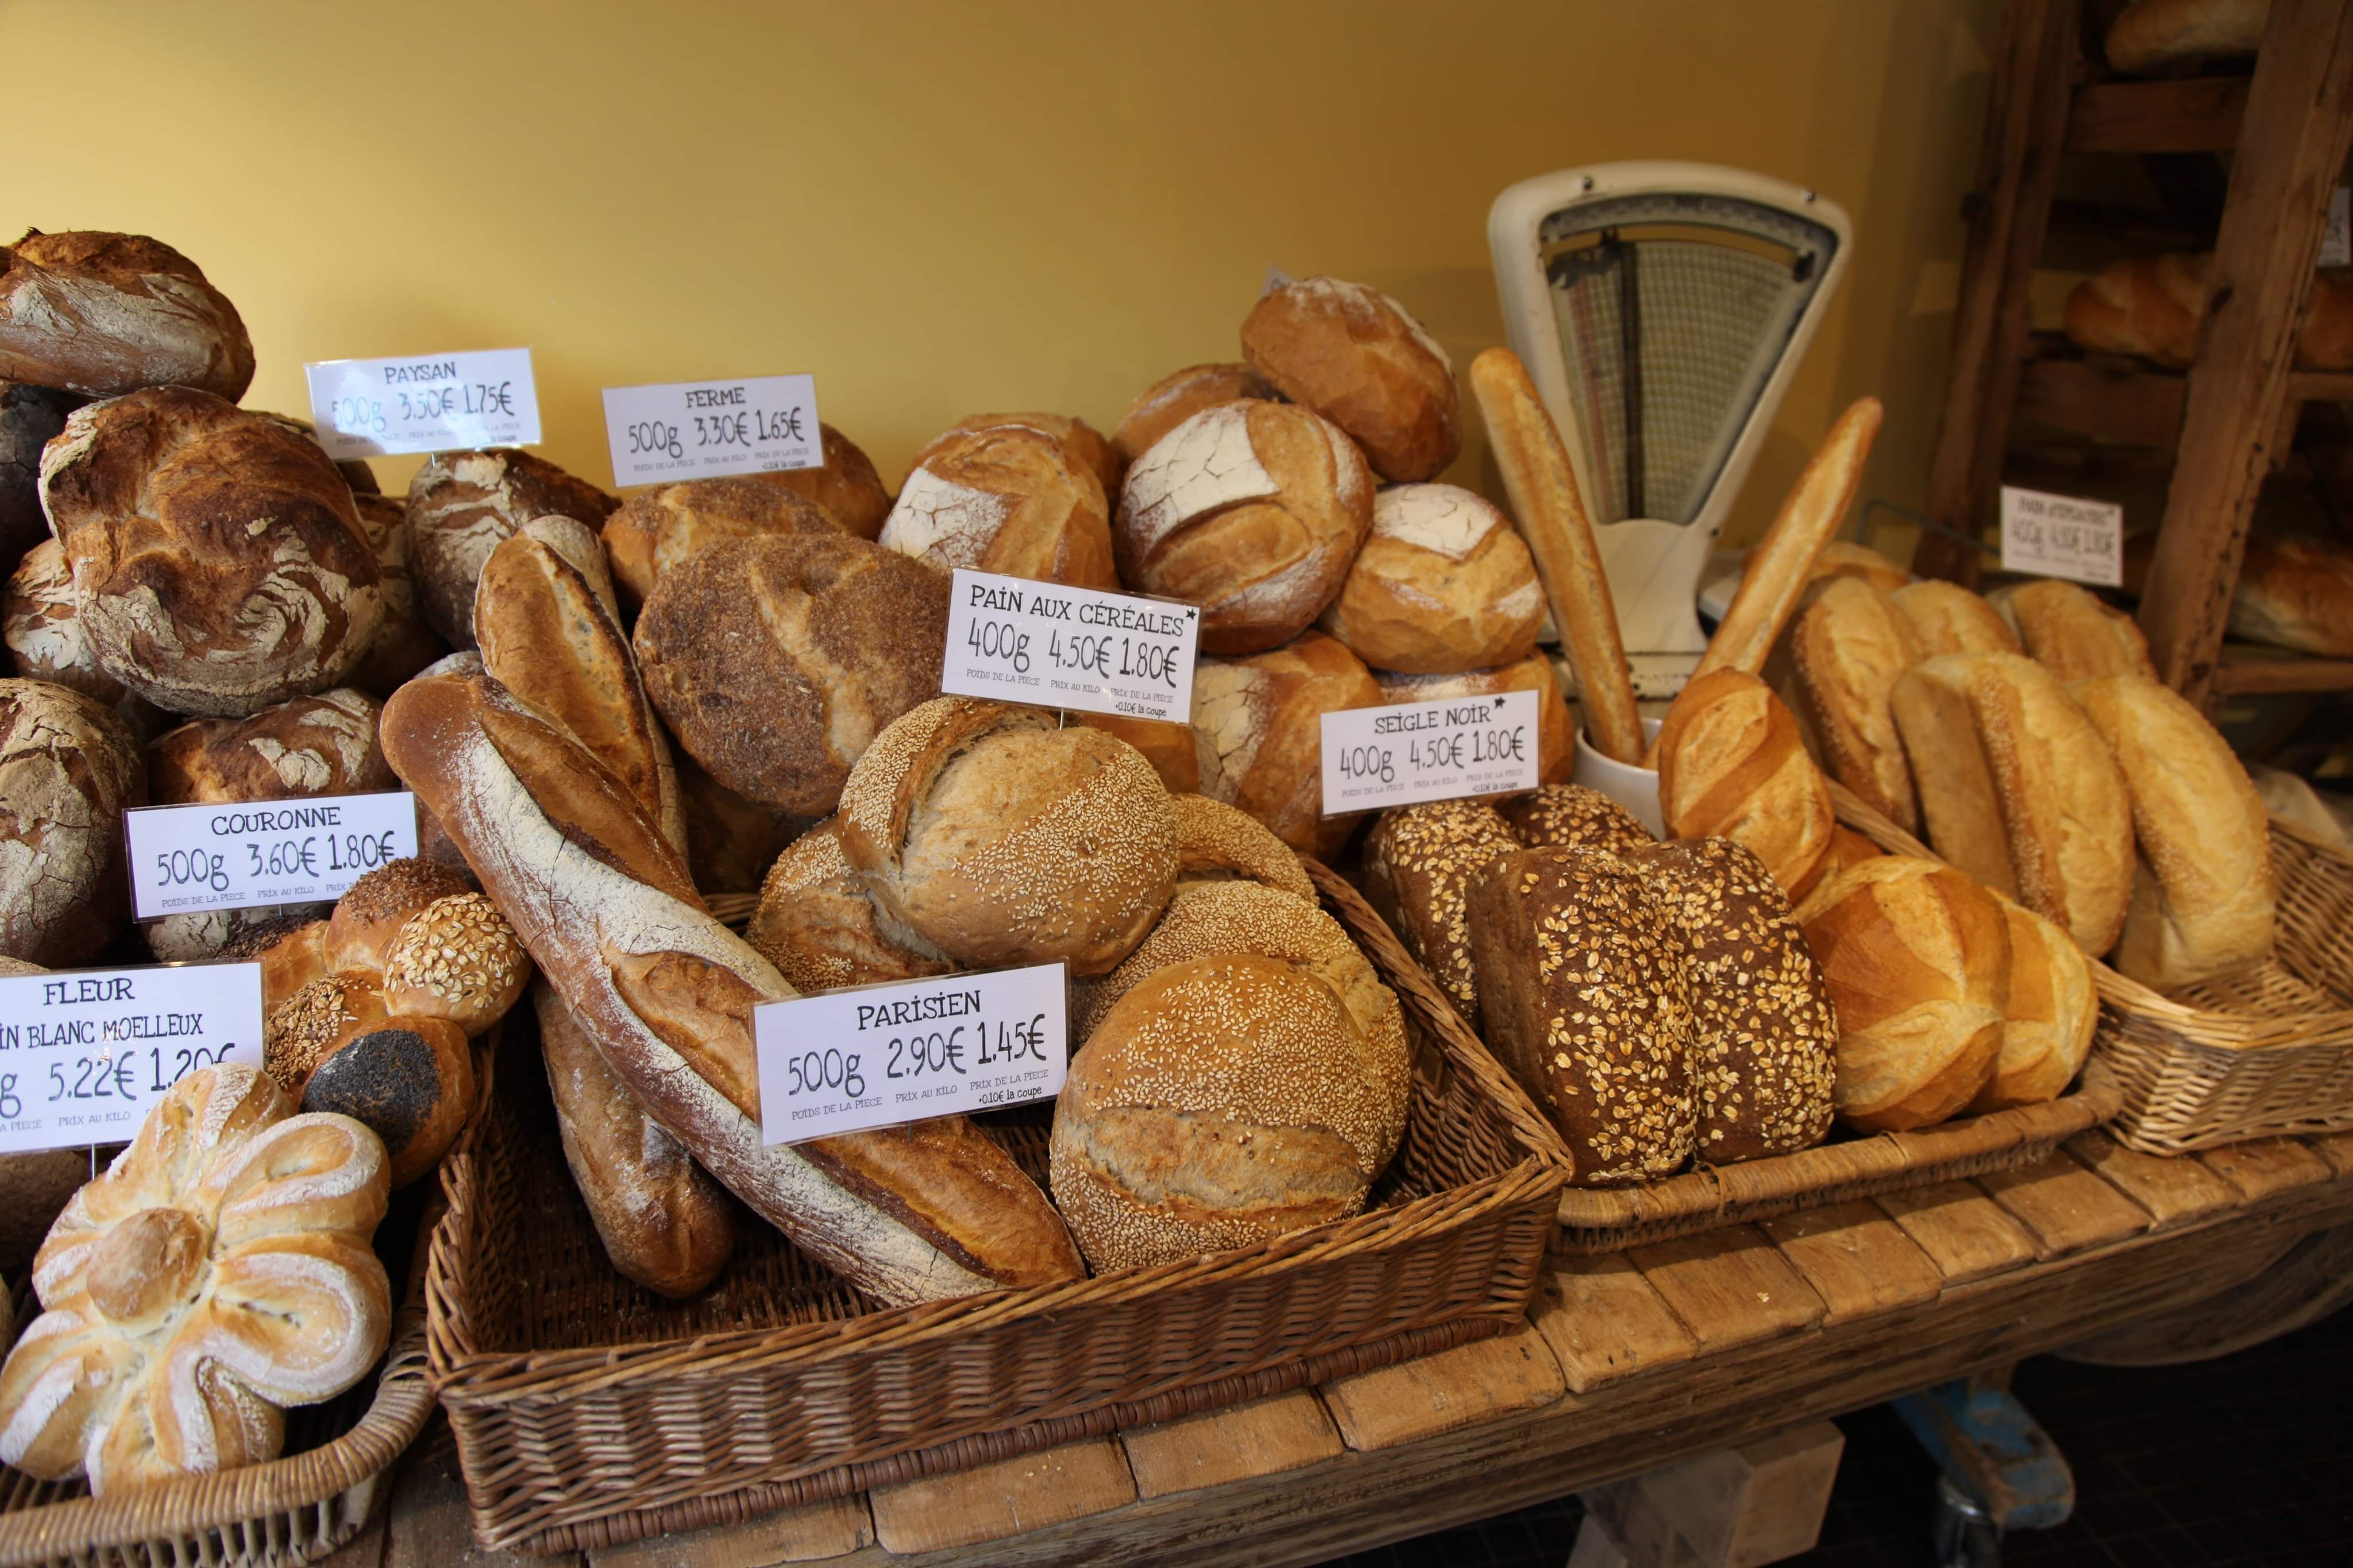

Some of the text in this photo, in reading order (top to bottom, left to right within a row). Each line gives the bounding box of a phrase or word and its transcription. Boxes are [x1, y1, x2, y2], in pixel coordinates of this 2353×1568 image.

[384, 362, 457, 384] PAYSAN
[331, 381, 515, 432] 500g 3.50€ 1.75€
[685, 387, 746, 408] FERME
[628, 407, 804, 458] 500g 3.30€ 1.65€
[970, 584, 1184, 637] PAIN AUX CÉRÉALES
[967, 617, 1180, 688] 400g 4.50€ 1.80€
[966, 668, 1040, 686] POIDS DE LA PIECE
[1050, 679, 1069, 689] PRIX
[1082, 684, 1100, 693] KILO
[1110, 688, 1174, 703] PRIX DE LA PIECE
[1137, 705, 1144, 714] la
[1146, 707, 1167, 719] coupe
[1374, 704, 1492, 734] SEIGLE NOIR
[1340, 726, 1525, 783] 400g 4.50€ 1.80€
[1500, 781, 1518, 791] coupe
[211, 806, 341, 836] COURONNE
[157, 831, 395, 891] 500g 3.60€ 1.80€
[257, 889, 278, 898] PRIX
[294, 886, 314, 895] KILO
[326, 883, 346, 892] PRIX
[162, 892, 245, 907] POIDS DE LA PIECE
[43, 978, 136, 1006] FLEUR
[857, 990, 982, 1030] PARISIEN
[27, 1020, 95, 1048] BLANC
[102, 1014, 204, 1042] MOELLEUX
[788, 1013, 1047, 1098] 500g 2.90€ 1.45€
[48, 1051, 137, 1102] 5.22€
[970, 1069, 1049, 1091] PRIX DE LA PIECE
[896, 1084, 957, 1103] PRIX AU KILO
[1006, 1089, 1015, 1100] la
[1017, 1087, 1043, 1099] coupe
[58, 1111, 131, 1126] PRIX AU KILO
[792, 1097, 882, 1121] POIDS DE LA PIECE
[11, 1119, 43, 1131] PIECE
